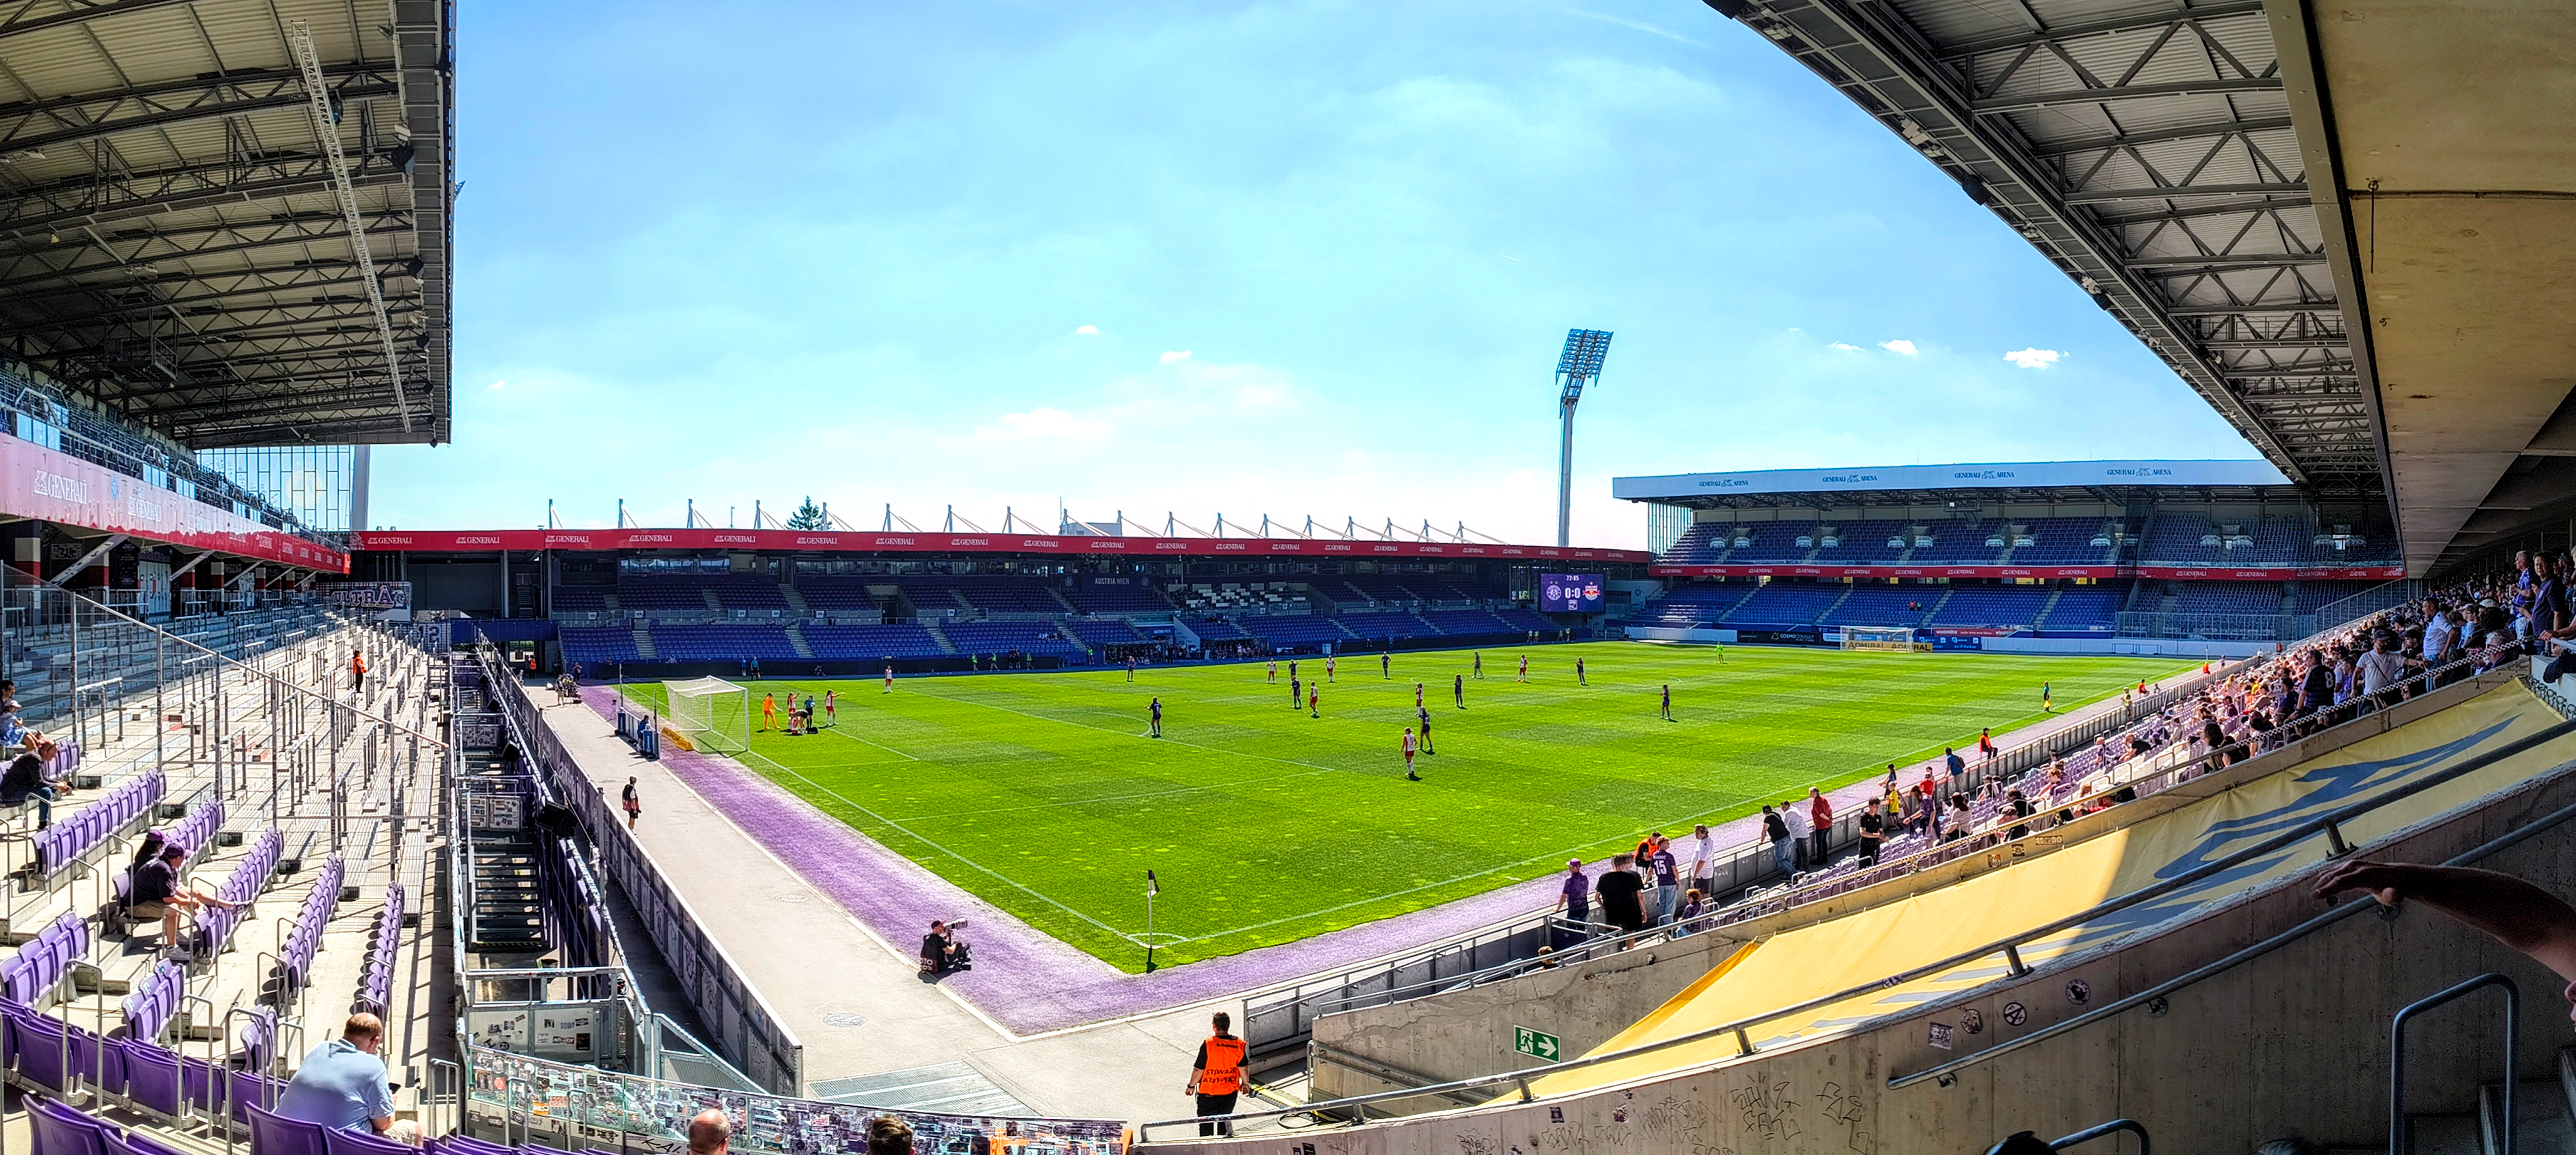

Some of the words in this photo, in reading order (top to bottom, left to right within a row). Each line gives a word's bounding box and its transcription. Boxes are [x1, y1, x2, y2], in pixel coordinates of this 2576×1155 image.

[48, 474, 87, 504] GENERALI
[136, 500, 161, 522] GENERALI
[1565, 588, 1580, 598] 0:0
[2324, 671, 2333, 689] 8
[1654, 860, 1667, 875] 15
